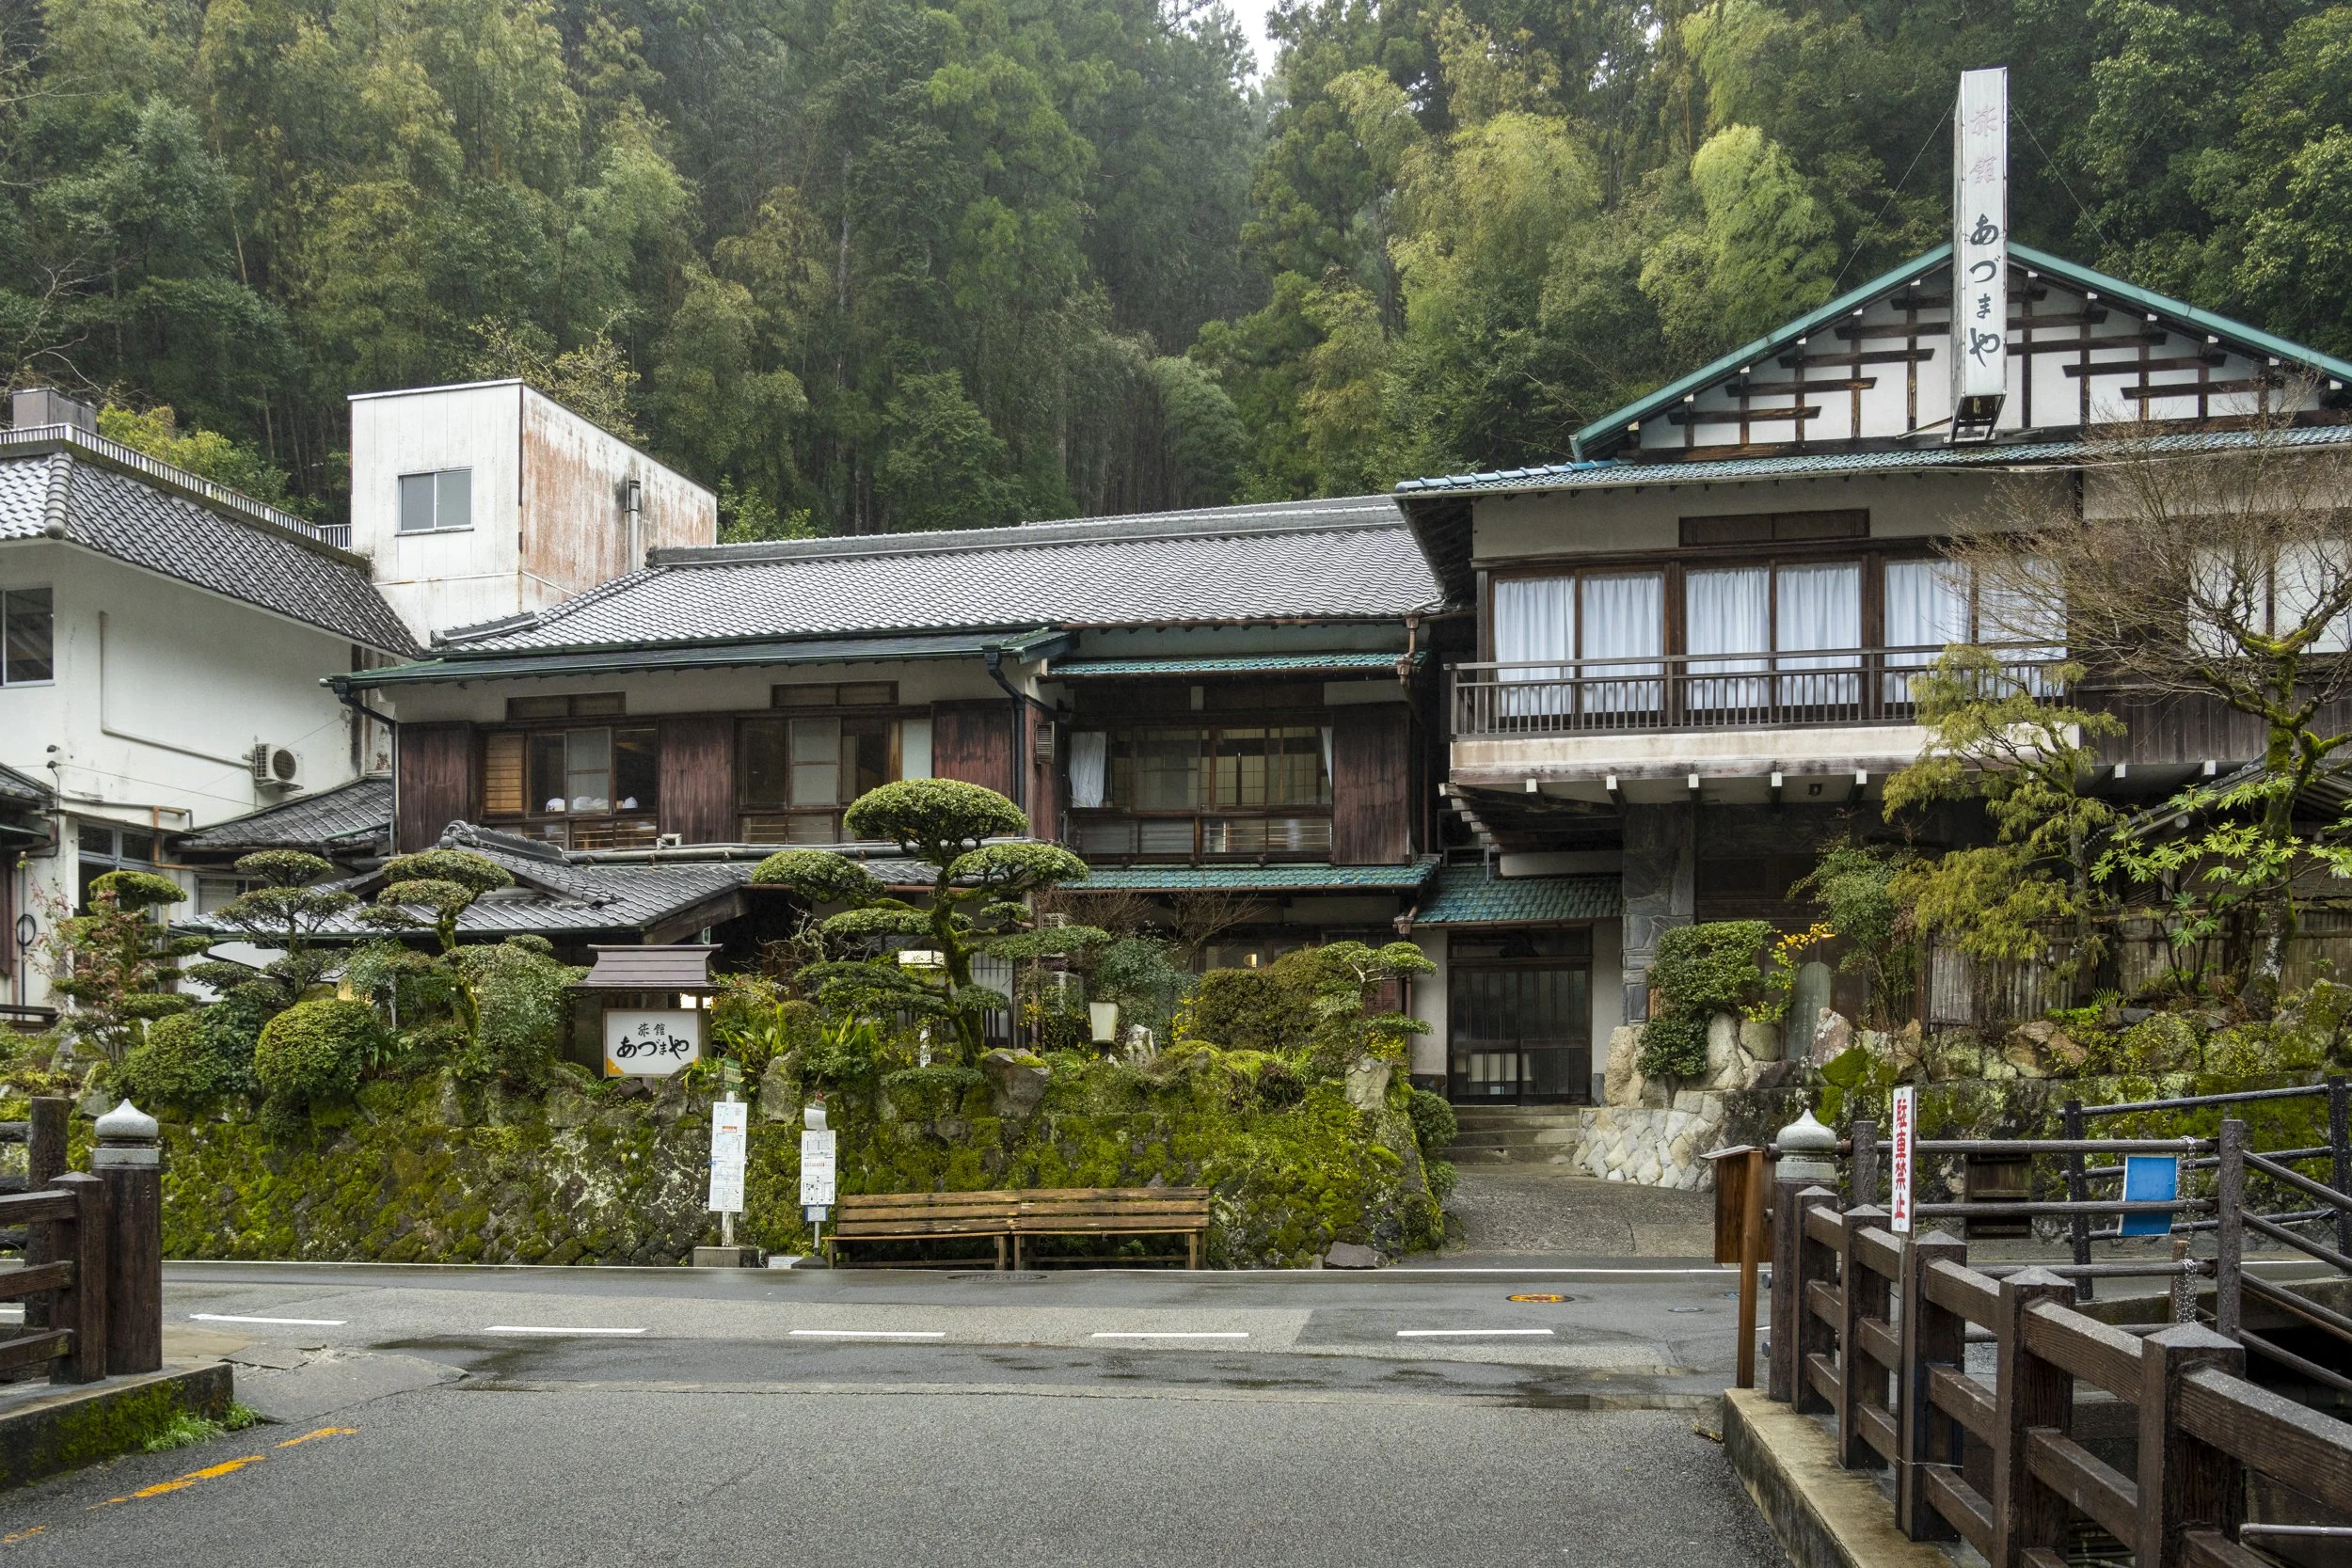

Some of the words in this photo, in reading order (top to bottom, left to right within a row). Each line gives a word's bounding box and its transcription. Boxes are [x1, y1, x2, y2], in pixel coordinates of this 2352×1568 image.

[1969, 214, 2001, 368] あづまや
[616, 1035, 690, 1060] あづまや
[638, 1022, 666, 1037] 旅館
[1895, 1099, 1908, 1220] 駐車禁止
